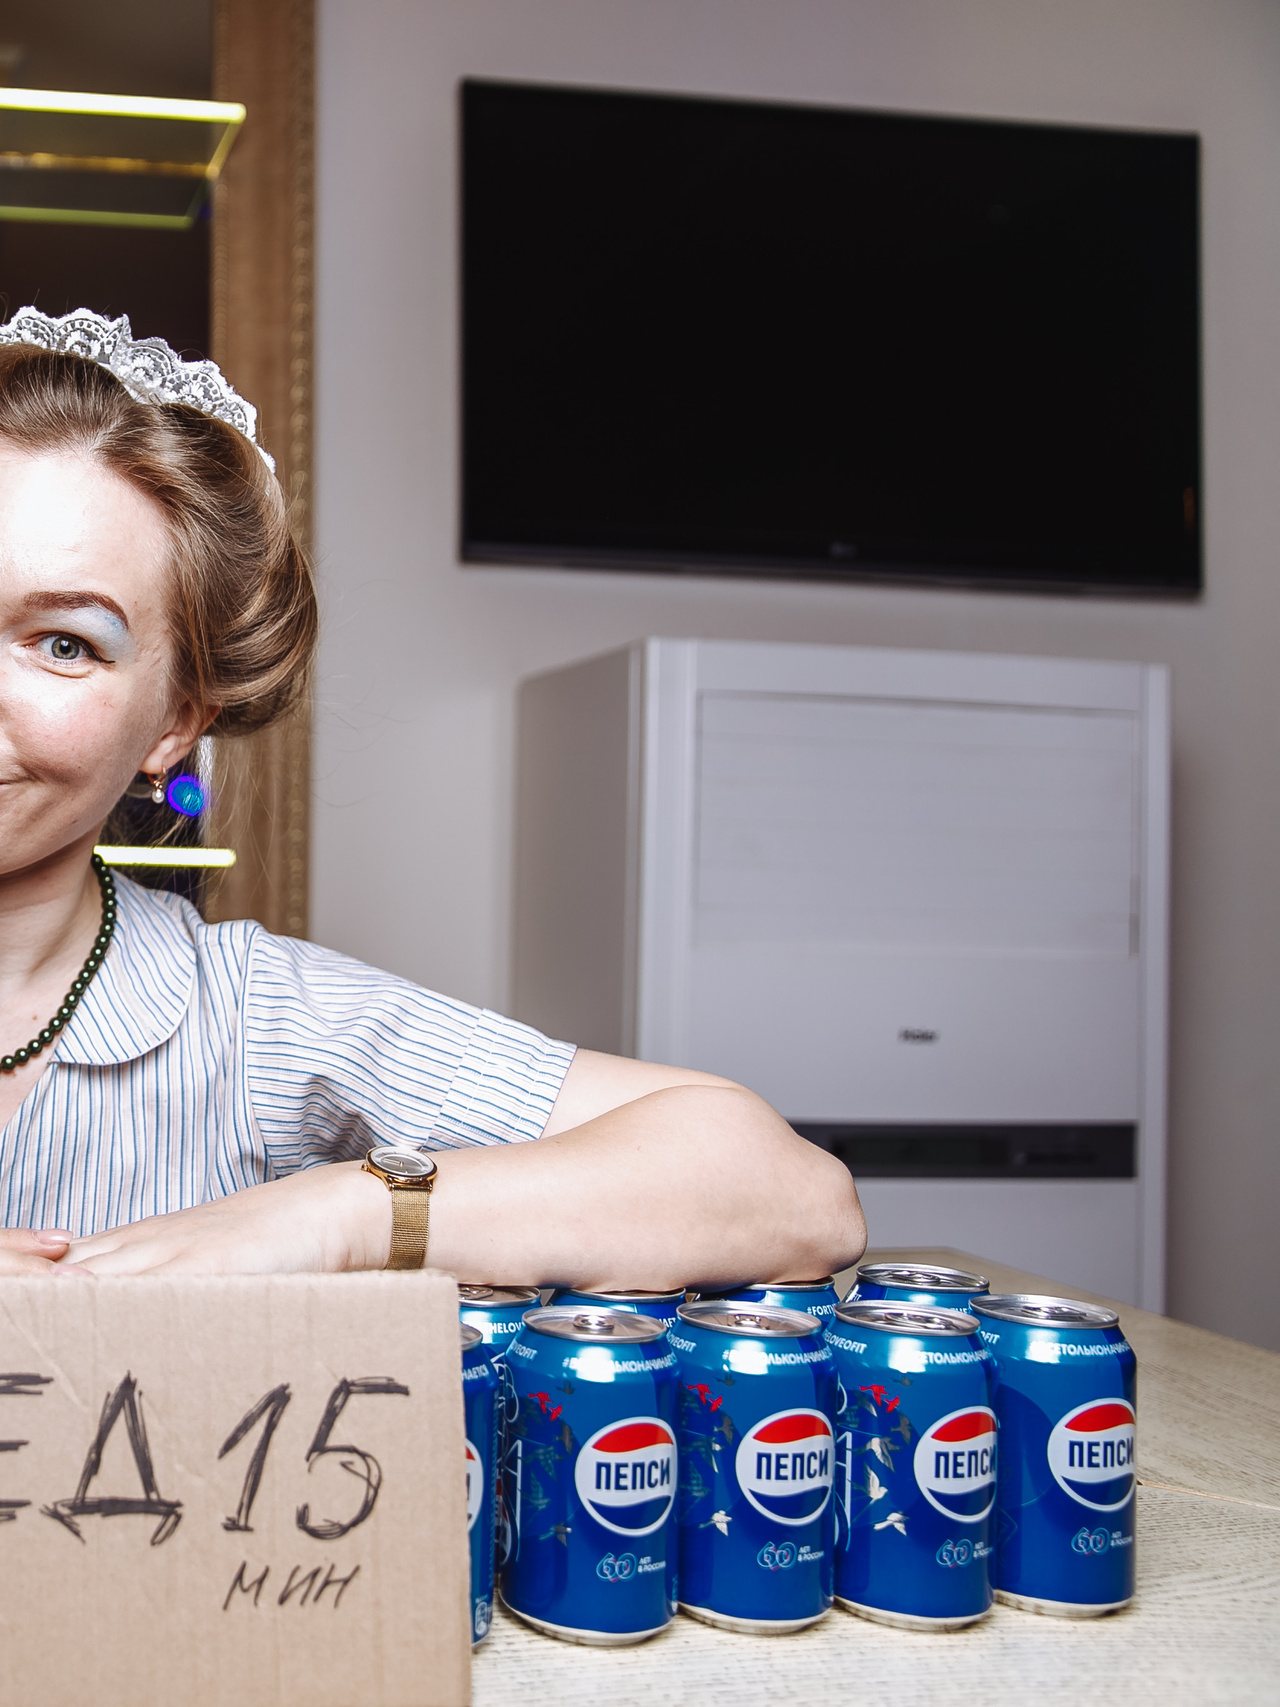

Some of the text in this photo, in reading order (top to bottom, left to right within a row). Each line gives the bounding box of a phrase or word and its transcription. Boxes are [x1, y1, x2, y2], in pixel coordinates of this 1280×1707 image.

[217, 1376, 411, 1540] 15
[756, 1447, 829, 1481] ПЕПСИ
[934, 1443, 997, 1479] ПЕПСИ
[1068, 1436, 1134, 1469] ПЕПСИ
[595, 1457, 670, 1491] ПЕПСИ
